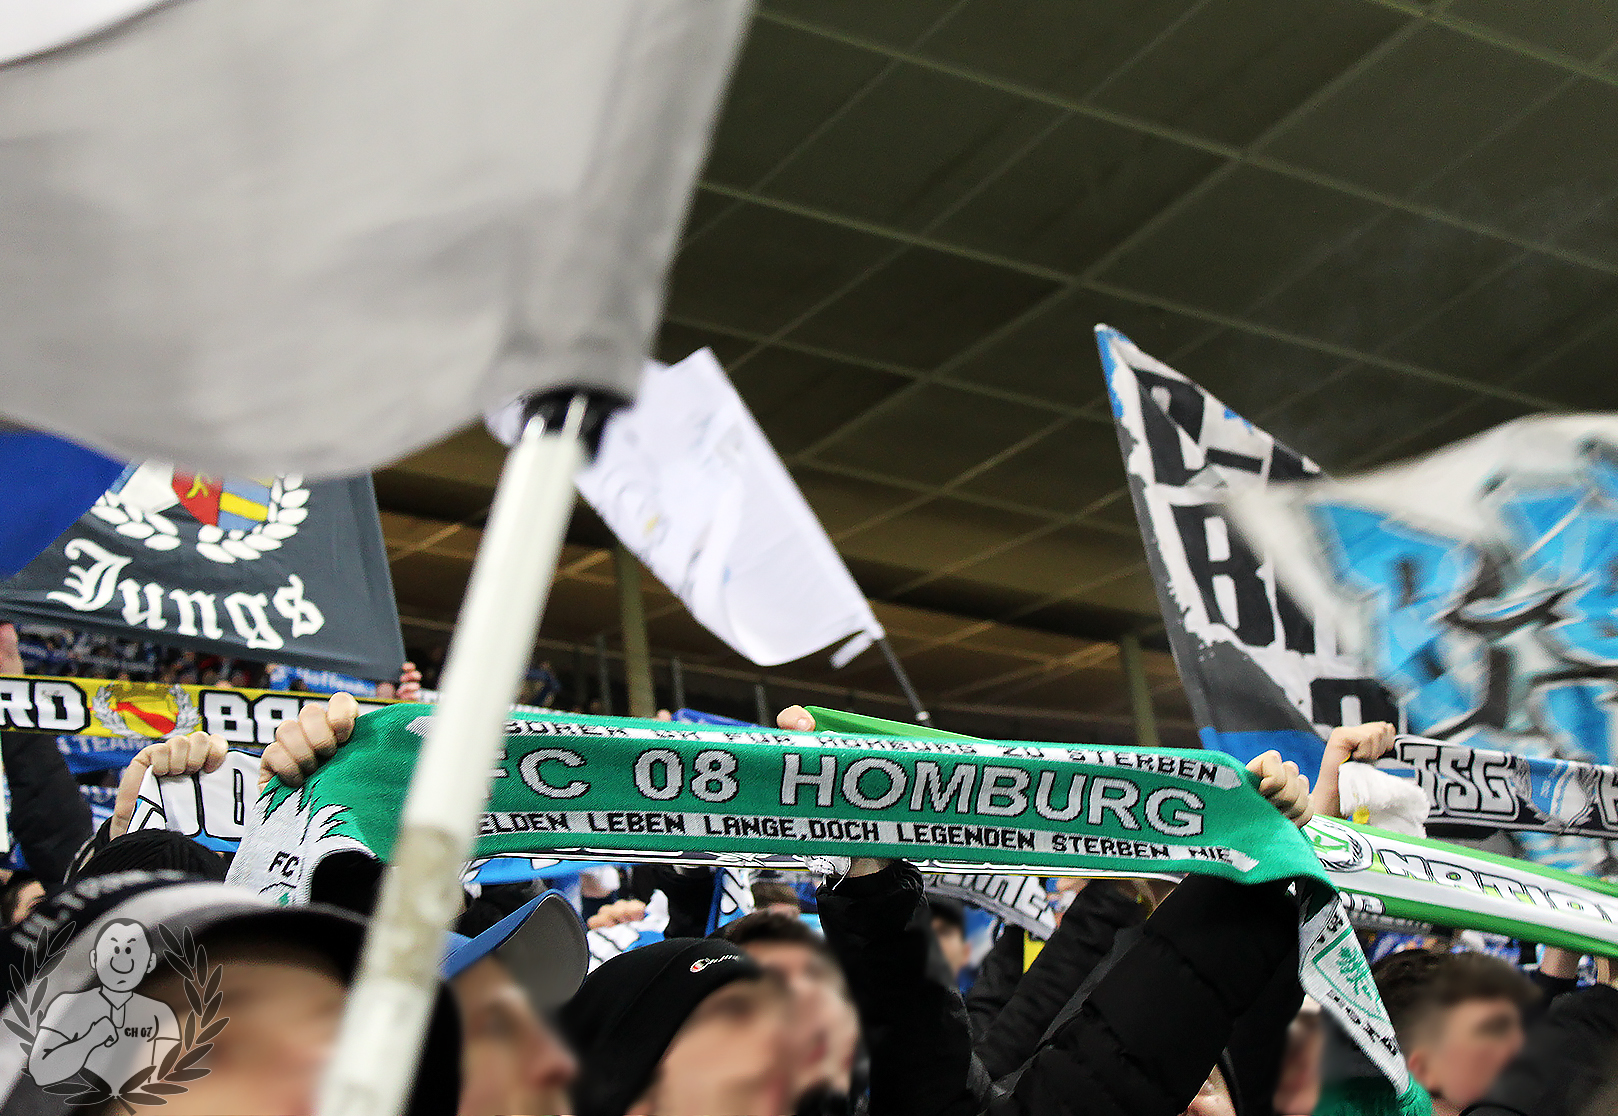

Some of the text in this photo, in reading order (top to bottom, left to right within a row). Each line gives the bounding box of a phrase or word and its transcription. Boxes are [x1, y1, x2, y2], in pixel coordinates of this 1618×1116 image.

[46, 537, 325, 650] Jungs
[1068, 749, 1218, 783] STERBEN
[489, 746, 1206, 837] C 08 HOMBURG
[480, 812, 571, 834] ELDEN
[587, 812, 686, 835] LEBEN
[896, 822, 1036, 851] LEGENDEN
[1052, 834, 1170, 859] STERBEN
[268, 850, 300, 878] FC
